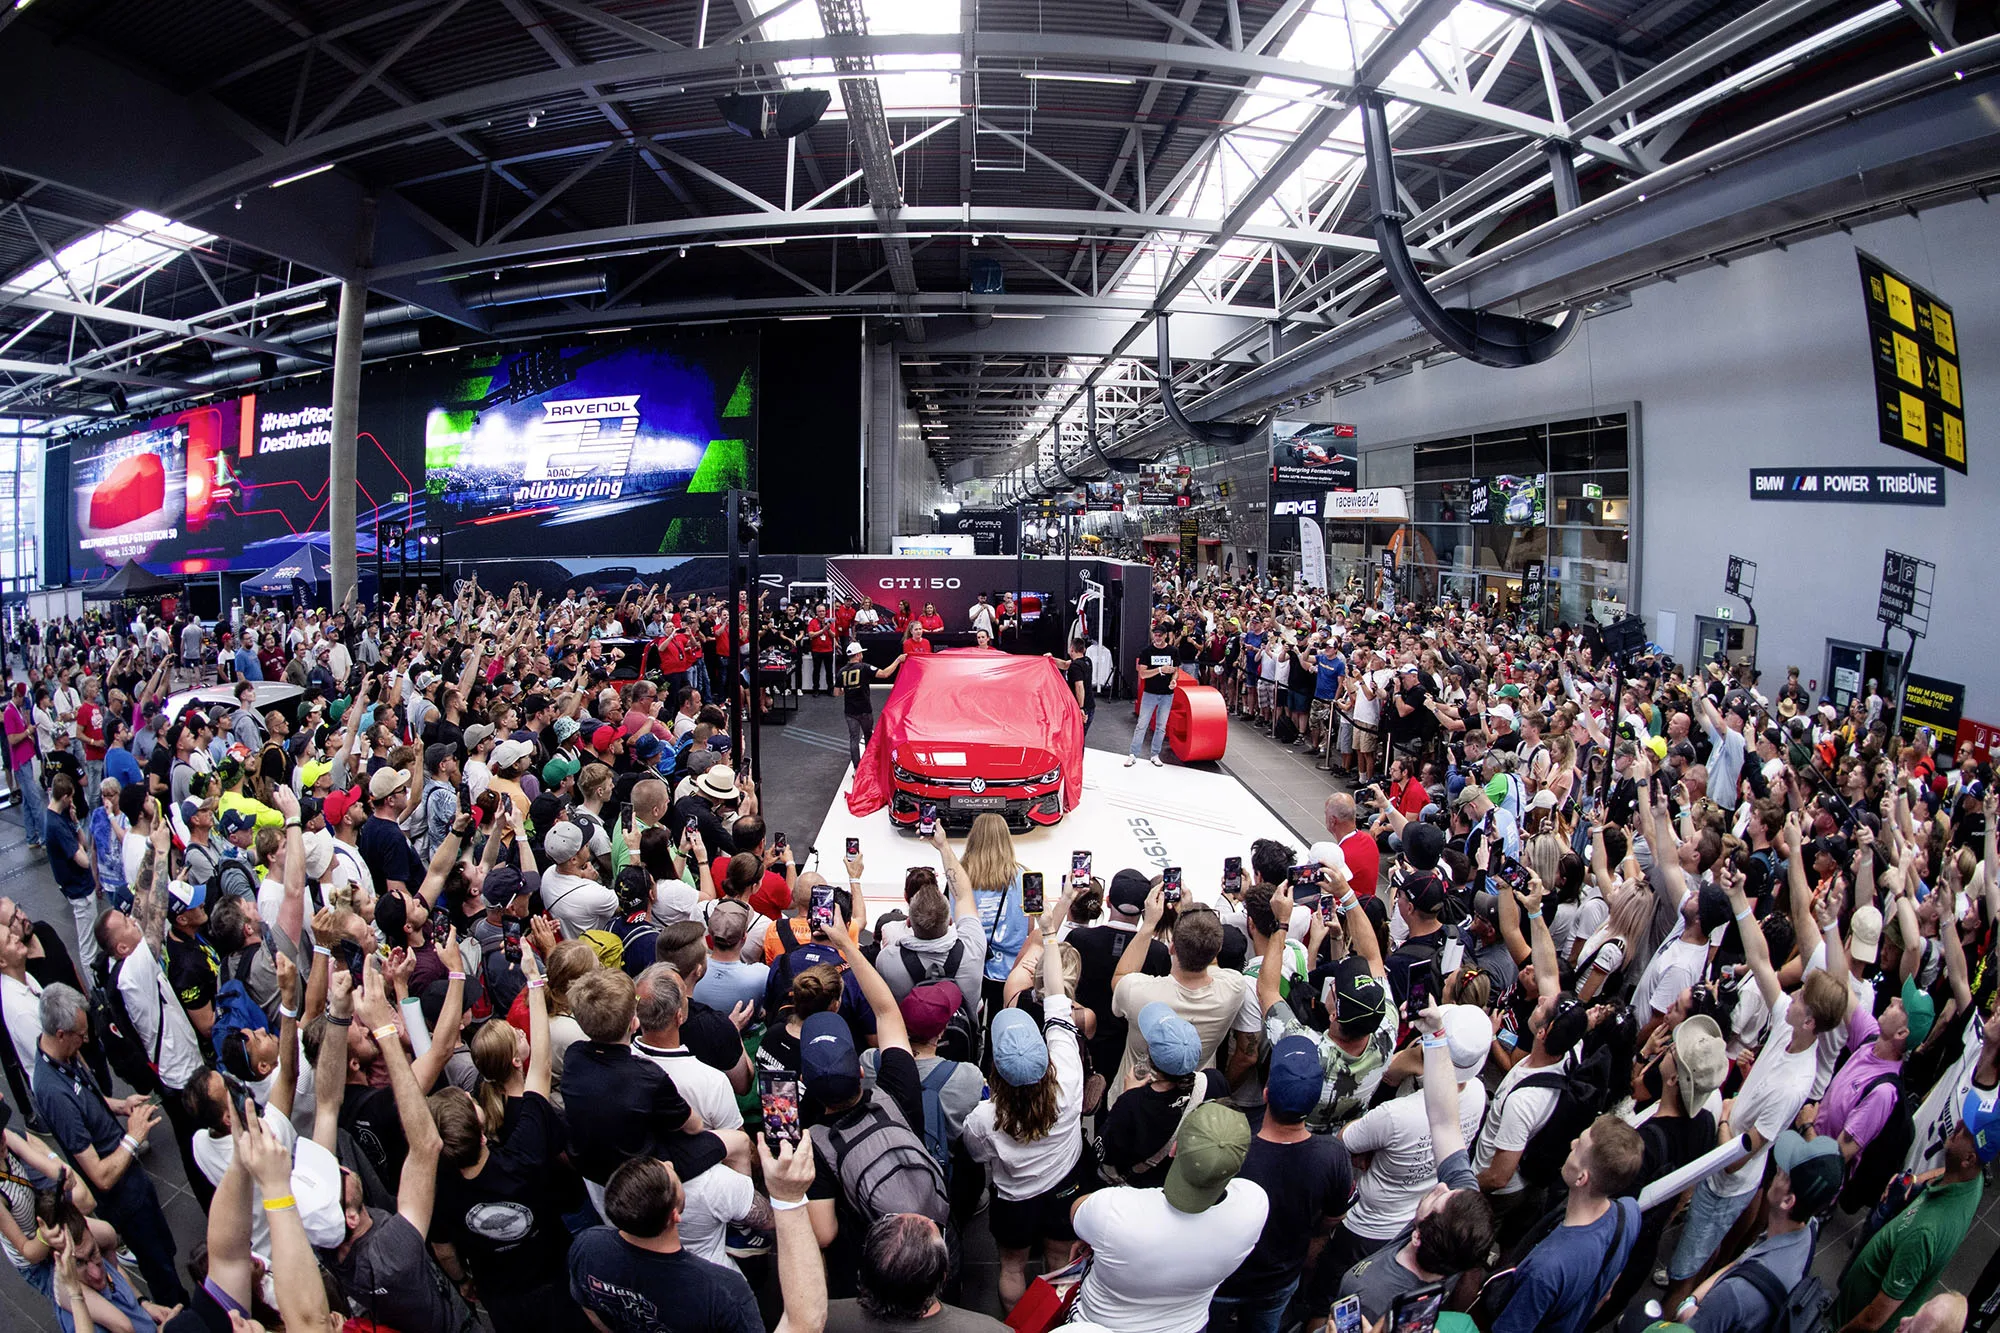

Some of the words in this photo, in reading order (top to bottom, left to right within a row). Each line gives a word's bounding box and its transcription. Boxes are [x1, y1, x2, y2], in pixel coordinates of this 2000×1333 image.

[551, 402, 630, 417] RAVENOL
[547, 468, 571, 478] ADAC
[519, 479, 623, 501] nürburgring
[1755, 476, 1784, 491] BMW
[1823, 476, 1870, 492] POWER
[1877, 473, 1937, 494] TRIBÜNE
[1335, 492, 1379, 508] racewear24
[1472, 485, 1487, 502] FAN
[1283, 500, 1317, 515] AMG
[1470, 499, 1488, 516] SHOP
[879, 577, 922, 589] GTI
[930, 577, 961, 589] 50
[1879, 607, 1897, 620] ENTRY
[841, 669, 860, 687] 10
[1907, 685, 1924, 695] BMW
[1924, 689, 1930, 697] M
[1930, 690, 1954, 703] POWER
